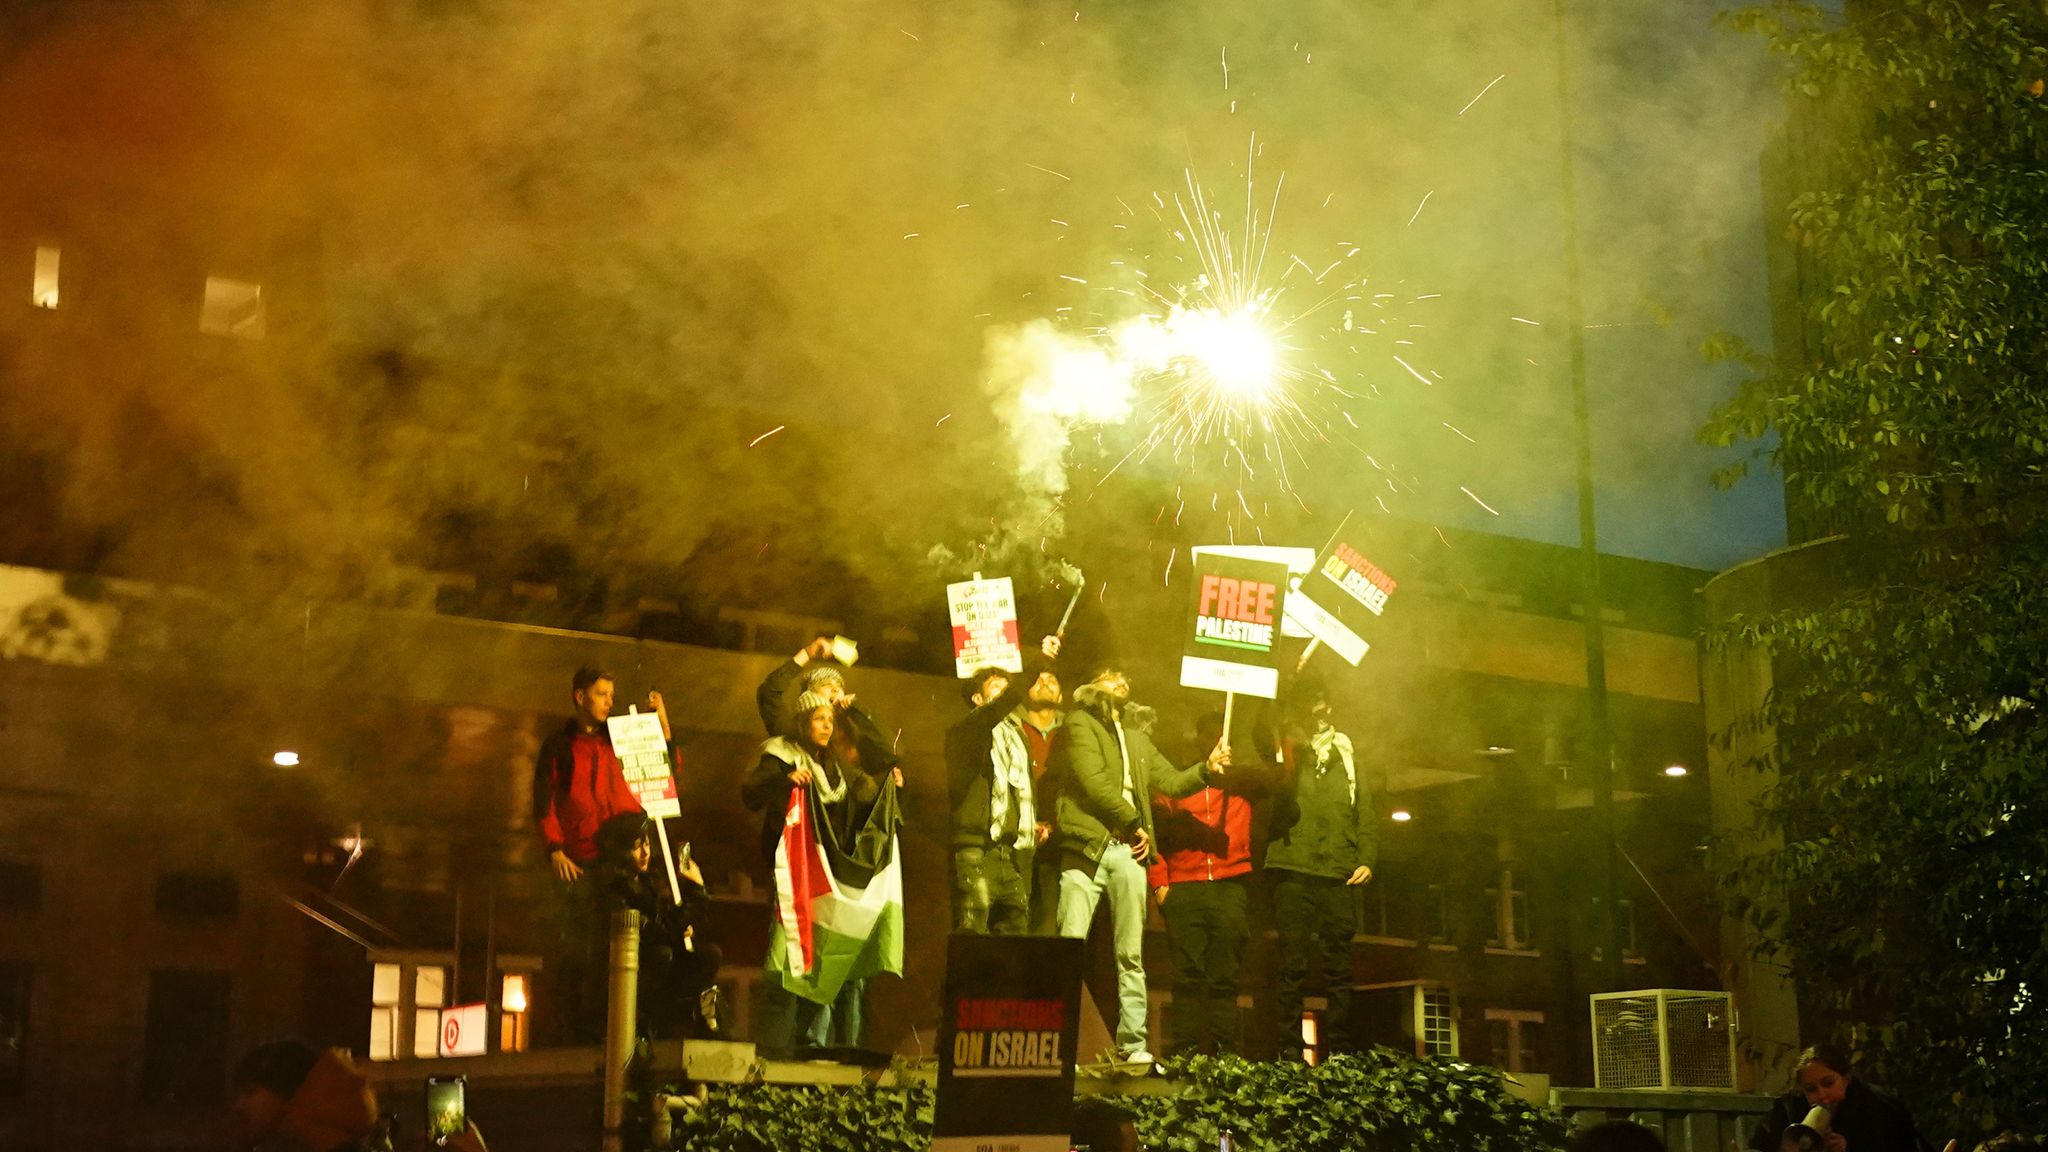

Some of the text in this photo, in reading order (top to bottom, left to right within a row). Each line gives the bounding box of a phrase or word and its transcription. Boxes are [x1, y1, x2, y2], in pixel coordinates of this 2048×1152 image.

[1324, 555, 1390, 613] ON ISRAEL
[1334, 542, 1397, 596] SANCTIONS
[955, 602, 973, 613] STOP
[1199, 575, 1277, 625] FREE
[967, 613, 977, 622] ON
[1197, 615, 1273, 647] PALESTINE
[956, 999, 1064, 1030] SANCTIONS
[954, 1031, 1062, 1067] ON ISRAEL
